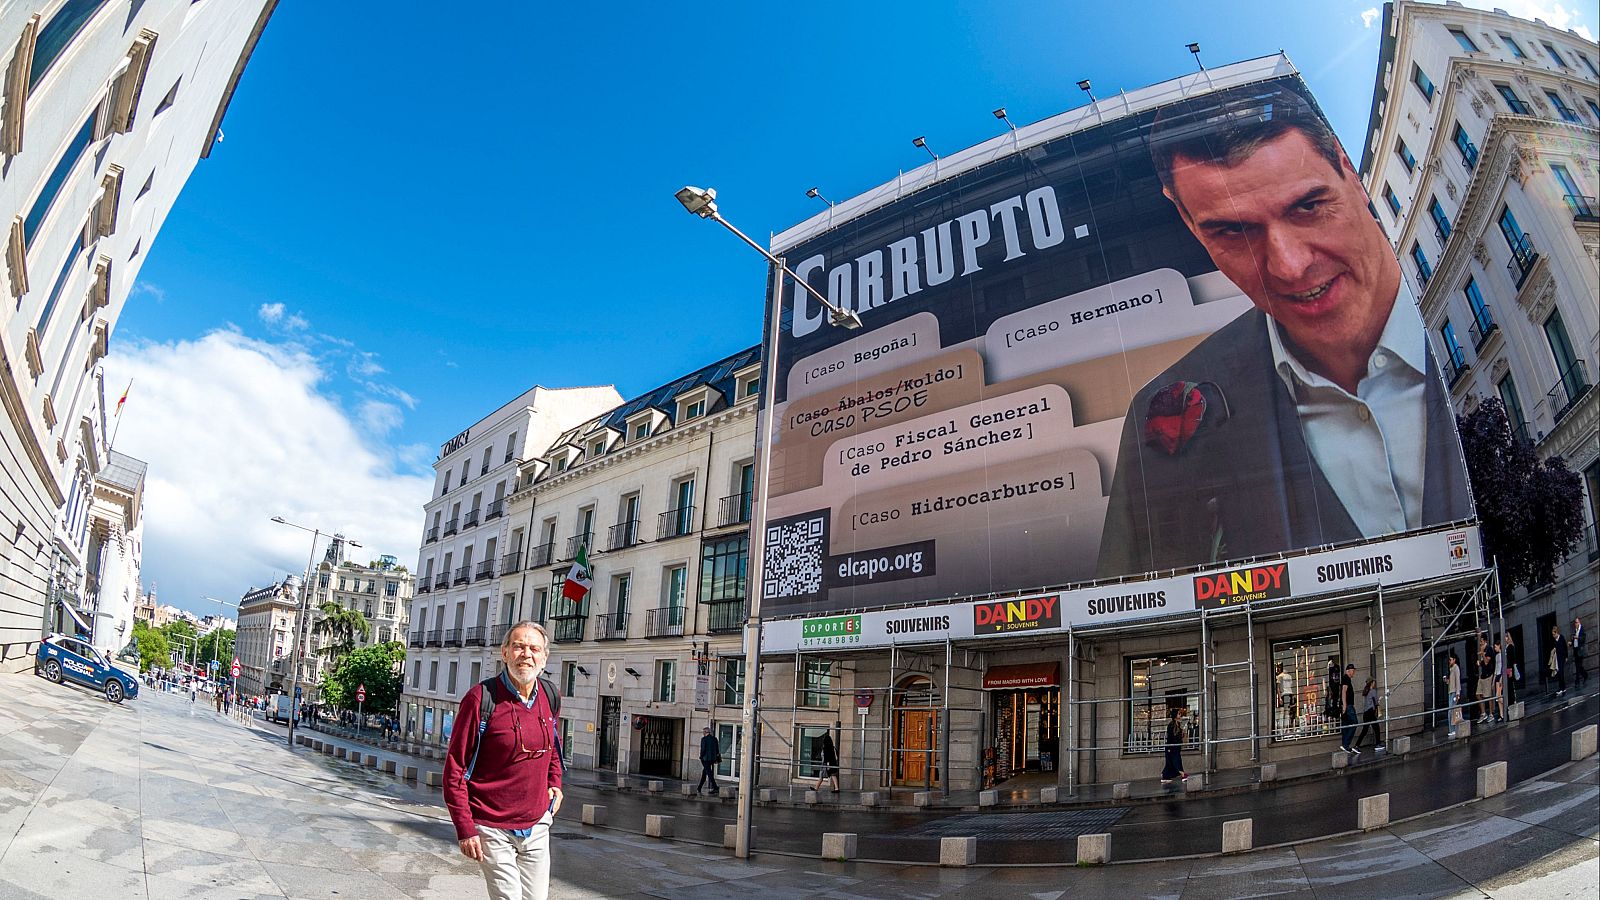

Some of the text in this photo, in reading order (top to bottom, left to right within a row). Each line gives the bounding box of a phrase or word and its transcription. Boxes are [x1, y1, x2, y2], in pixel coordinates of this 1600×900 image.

[1005, 289, 1163, 348] [Caso Hermano]
[805, 333, 917, 384] [Caso Begoña]
[790, 364, 963, 430] [Caso Ábalos/Koldo]
[862, 389, 928, 422] PSOE
[839, 398, 1051, 465] [Caso Fiscal General
[851, 423, 1033, 477] de Pedro Sánchez]
[852, 472, 1075, 531] [Caso Hidrocarburos]
[838, 550, 923, 579] elcapo.org
[1316, 554, 1394, 583] SOUVENIRS
[1196, 564, 1286, 600] DANDY
[975, 597, 1057, 625] DANDY
[1088, 590, 1167, 616] SOUVENIRS
[1232, 591, 1267, 604] SOUVENIRS
[804, 620, 860, 633] SOPORTES
[886, 615, 950, 635] SOUVENIRS
[1006, 620, 1039, 630] SOUVENIRS
[803, 635, 860, 646] 91 748 98 99
